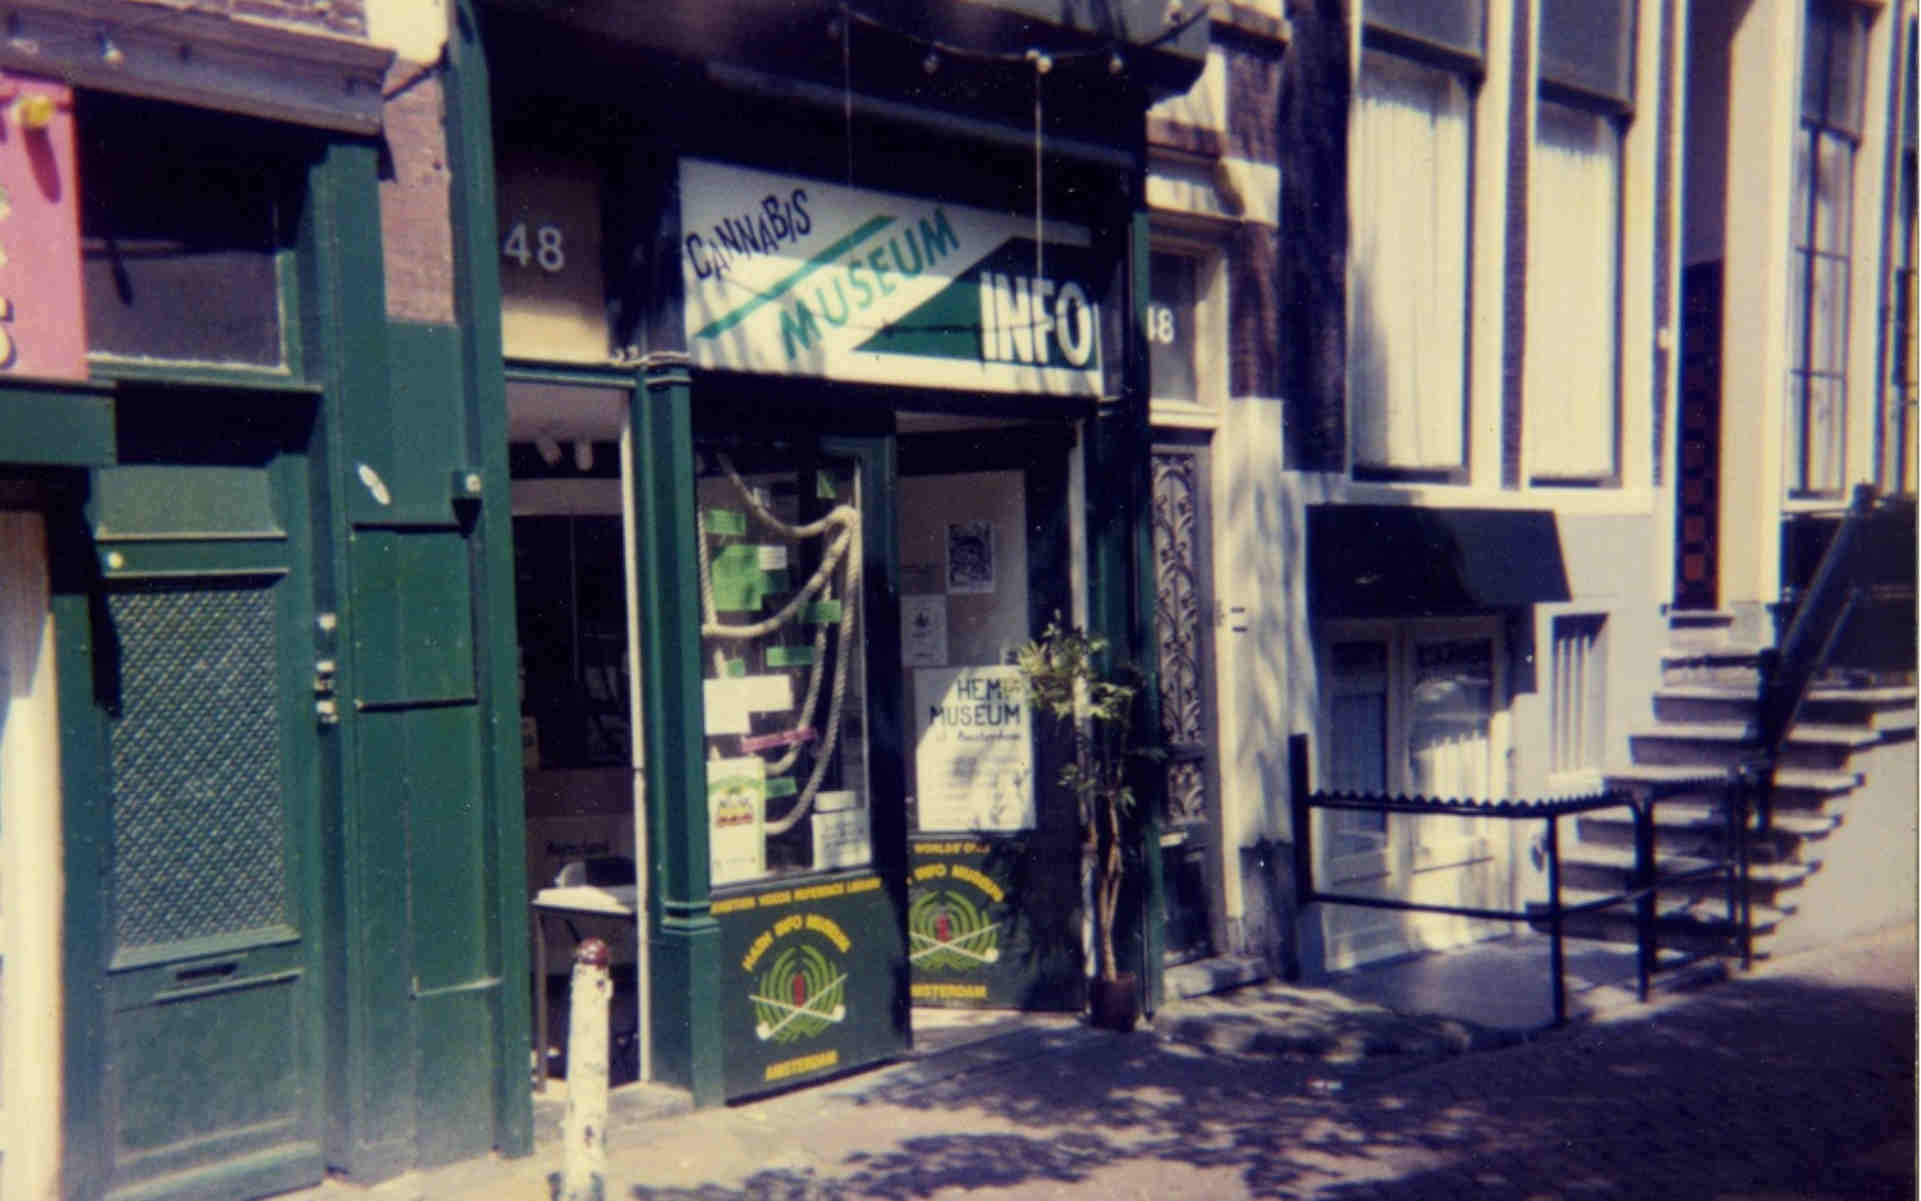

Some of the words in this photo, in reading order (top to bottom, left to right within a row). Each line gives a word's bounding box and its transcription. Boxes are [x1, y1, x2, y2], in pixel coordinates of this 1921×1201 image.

[503, 222, 565, 273] 48
[686, 189, 811, 280] CANNABIS
[779, 208, 961, 361] MUSEUM
[980, 271, 1093, 366] INFO
[928, 703, 1021, 726] MUSEUM
[909, 983, 988, 999] MSTERDAM
